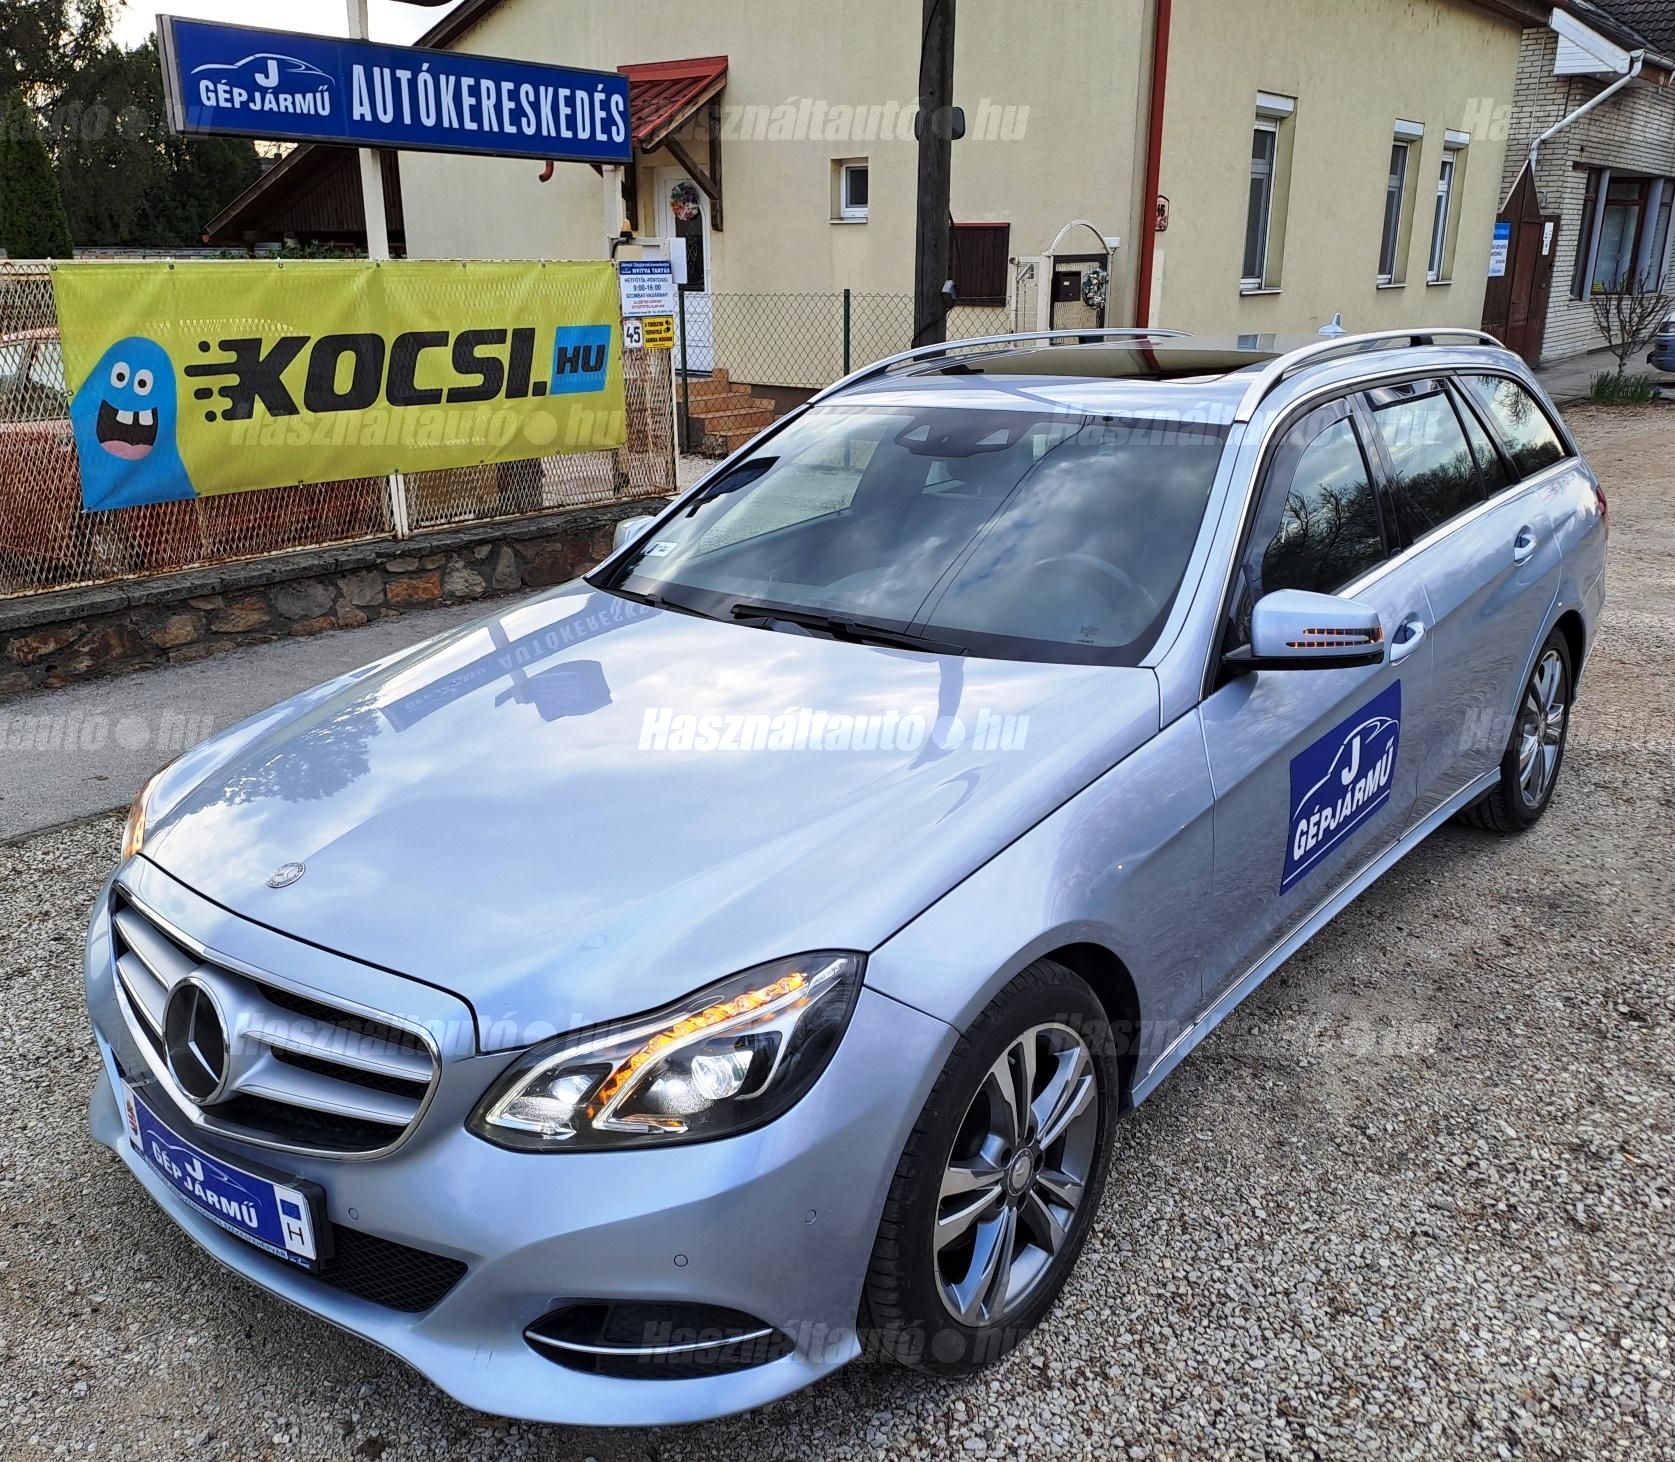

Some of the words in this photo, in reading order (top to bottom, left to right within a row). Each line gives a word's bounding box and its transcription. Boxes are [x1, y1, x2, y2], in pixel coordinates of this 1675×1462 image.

[199, 77, 331, 117] GÉPJÁRMŰ
[352, 62, 625, 143] AUTÓKERESKEDÉS
[626, 326, 640, 343] 45
[1341, 735, 1361, 785] J
[1293, 736, 1395, 861] GÉPJÁRMŰ
[288, 1222, 305, 1246] H
